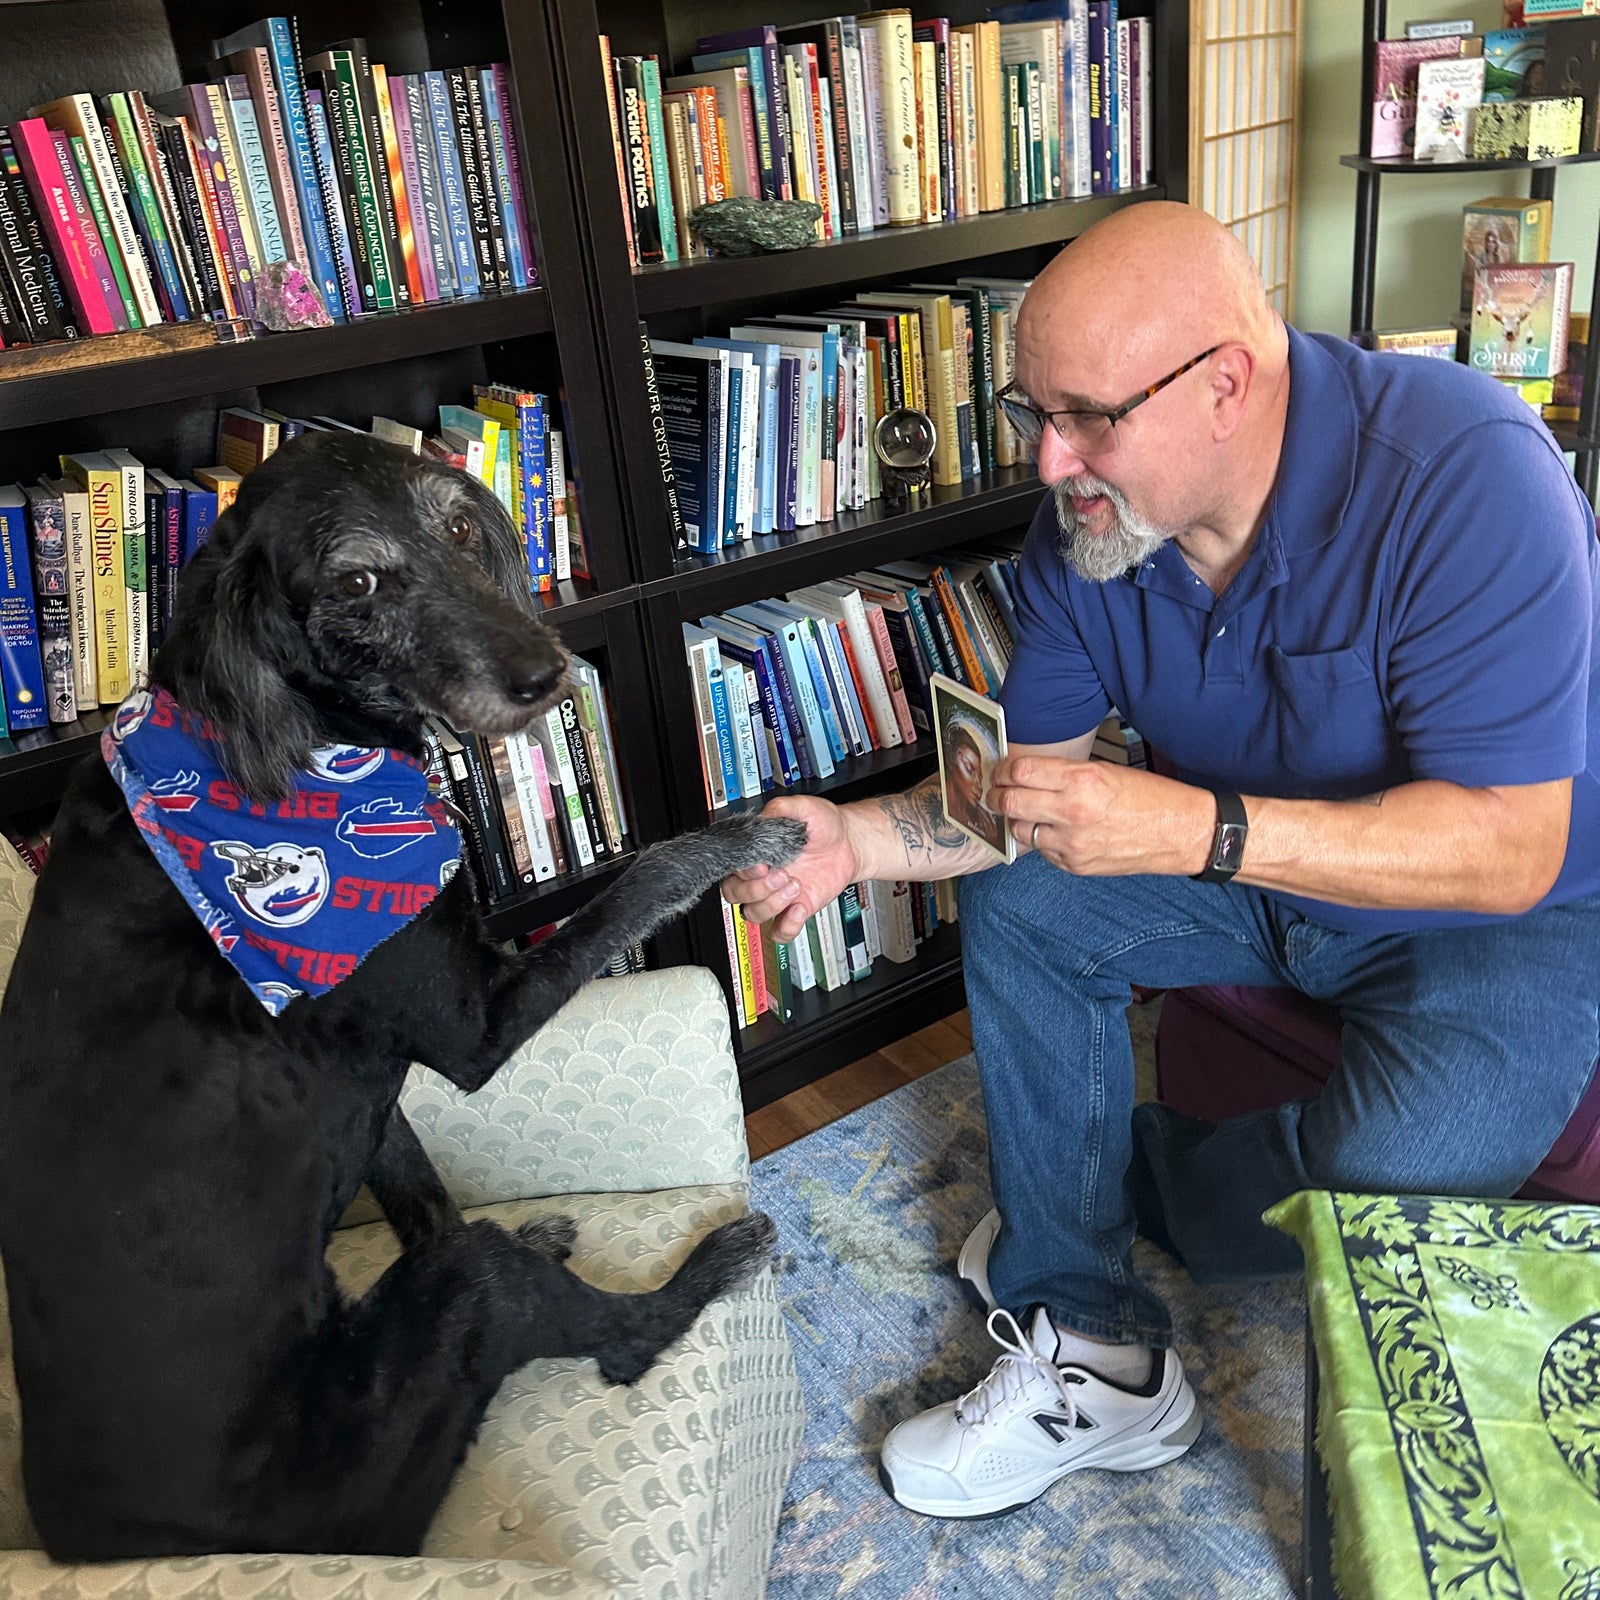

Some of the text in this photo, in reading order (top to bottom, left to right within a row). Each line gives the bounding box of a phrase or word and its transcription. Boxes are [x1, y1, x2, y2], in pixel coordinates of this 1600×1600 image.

[896, 23, 912, 133] Sacred Contracts
[1090, 63, 1101, 118] Channeling
[1119, 26, 1130, 112] EVERYDAY MAGIC
[283, 66, 316, 183] HANDS OF LIGHT
[706, 94, 720, 165] AUTOBIOGRAPHY
[771, 86, 785, 137] AYURVEDA
[828, 34, 849, 169] THE MOST HAUNTED PLACES
[938, 52, 949, 167] MUTANT DOWN UNDER
[102, 125, 116, 154] COLOR
[241, 121, 269, 194] THE REIKI
[407, 85, 440, 237] Reiki Guide
[451, 73, 491, 266] Reiki The Ultimate Guide Vol. 3 MURRAY
[469, 79, 500, 227] Reiki False Beliefs For All
[625, 88, 650, 209] PSYCHIC POLITICS
[757, 111, 772, 170] ULTIMATE HEALING
[814, 108, 830, 214] COMPLETE WORKS
[54, 141, 86, 215] UNDERSTANDING
[79, 217, 101, 257] AURAS
[81, 101, 135, 256] Chakras, Auras, and the New Spirituality
[137, 173, 149, 199] Color
[341, 81, 386, 281] An Outline of CHINESE ACUPUNCTURE
[431, 78, 470, 267] Reiki The Ultimate Guide Vol. 2 MURRAY
[51, 187, 71, 222] Auras
[196, 219, 208, 245] READ
[219, 190, 248, 263] CRYSTAL REIKI
[349, 193, 367, 263] RICHARD GORDON
[16, 253, 49, 325] Medicine
[981, 294, 992, 381] SPIRITWALKER
[1474, 341, 1547, 368] SPIRIT
[732, 377, 740, 400] Crystal
[825, 374, 834, 427] Stones Alive!
[903, 351, 911, 391] SHAMANIC
[741, 370, 751, 433] Cosmic Crystals
[790, 390, 800, 417] Crystal
[804, 386, 813, 448] Energy Protection
[649, 414, 676, 483] CRYSTALS
[790, 418, 799, 449] Healing
[544, 467, 554, 522] Mirror Gazing
[551, 450, 562, 496] GHOST GIRL
[69, 511, 84, 565] Dane Rudhyar
[90, 480, 119, 577] SunShines
[167, 505, 179, 565] ASTROLOGY
[197, 507, 206, 520] THE
[667, 488, 682, 531] JUDY HALL
[130, 571, 137, 579] &
[555, 519, 566, 573] TOREY HAYDEN
[73, 568, 89, 659] The Astrological Houses
[104, 607, 118, 668] Michael Lutin
[873, 609, 896, 669] ANGEL THERAPY
[909, 591, 944, 672] LIFE BETWEEN LIFE
[772, 639, 797, 721] MAY THE ANGELS WITH
[12, 708, 43, 716] TOPQUARK
[560, 699, 575, 730] Oola
[713, 685, 734, 775] UPSTATE CAULDRON
[763, 686, 782, 742] LIFE AFTER LIFE
[550, 723, 570, 768] BALANCE
[571, 728, 591, 784] FIND BALANCE
[738, 717, 756, 778] Ask Your Angels
[461, 781, 485, 853] THE POWER MYTH
[568, 795, 582, 818] Oola
[494, 852, 503, 869] ROBERT
[332, 875, 437, 915] BILLS
[843, 886, 856, 918] PLANTS
[750, 934, 763, 1002] FOOD HEALING
[777, 943, 787, 969] ALING
